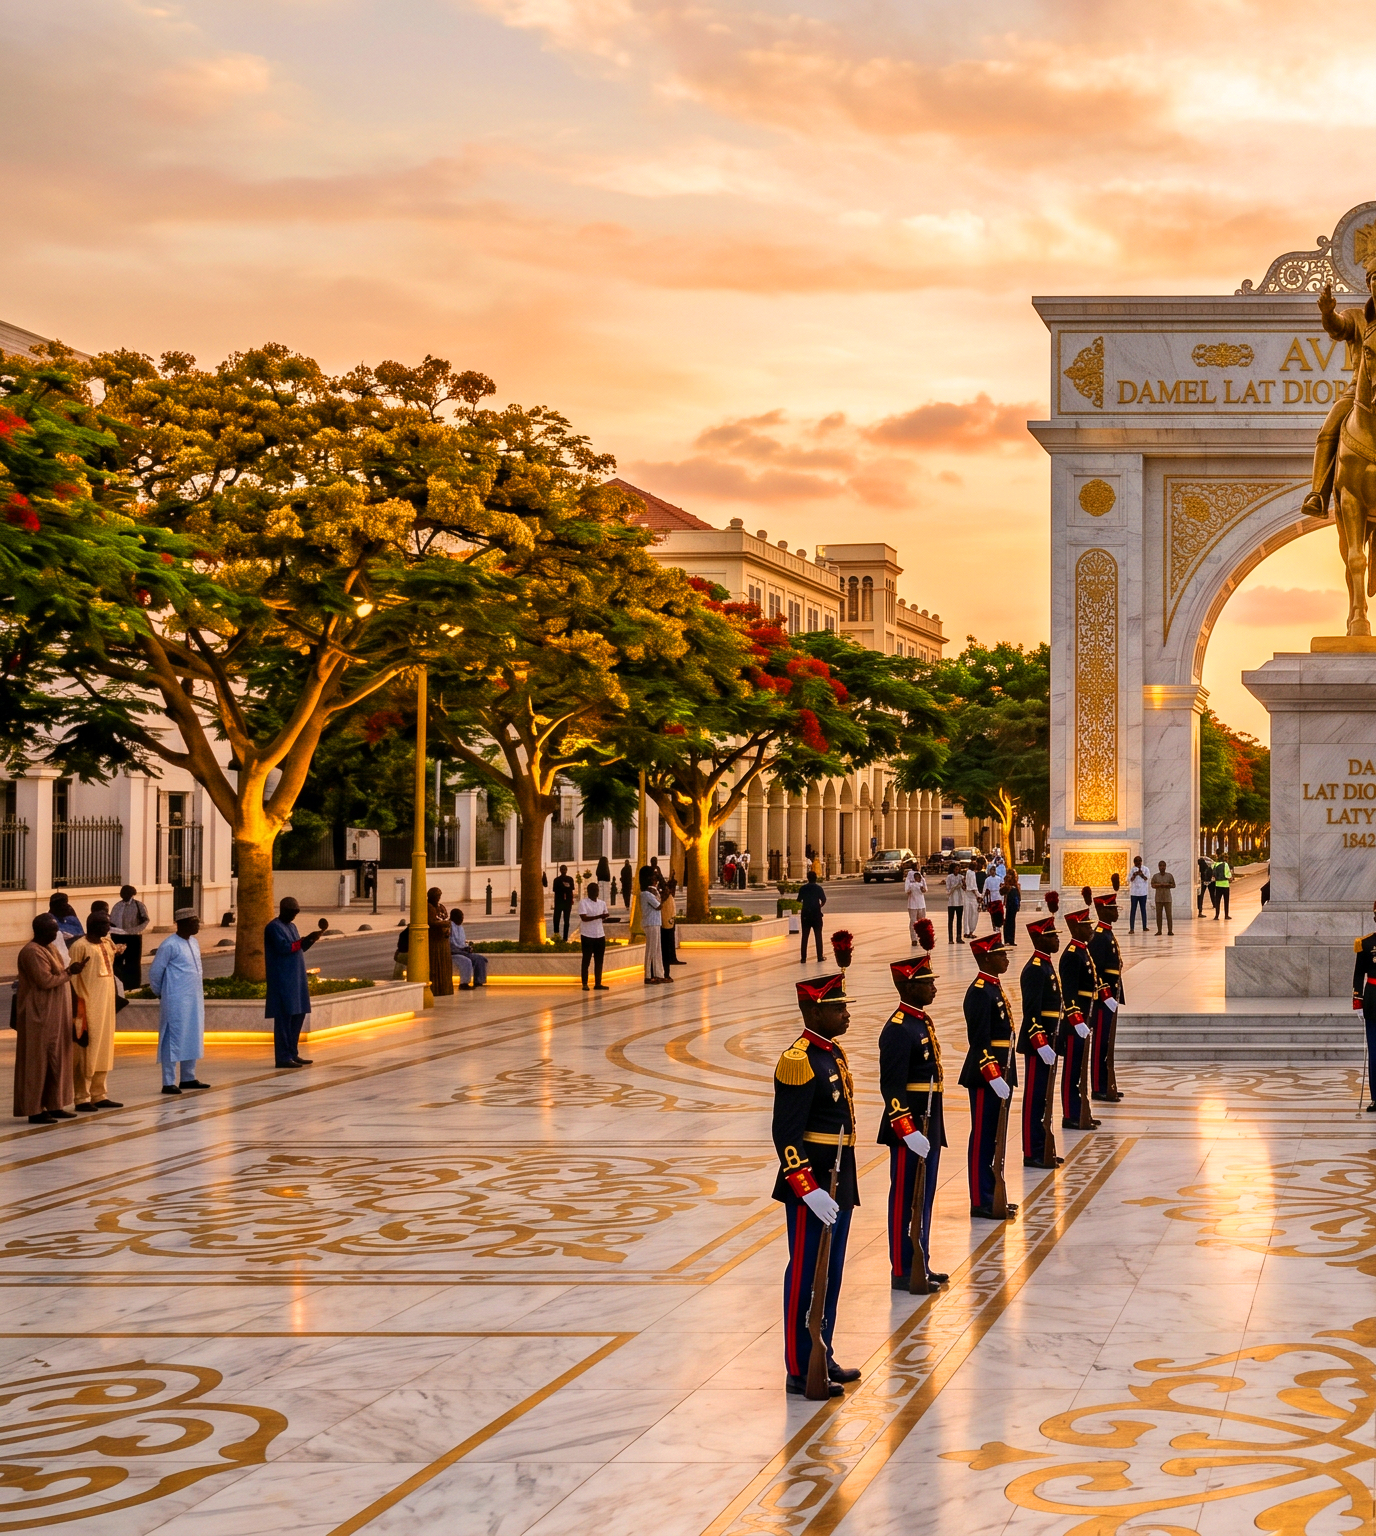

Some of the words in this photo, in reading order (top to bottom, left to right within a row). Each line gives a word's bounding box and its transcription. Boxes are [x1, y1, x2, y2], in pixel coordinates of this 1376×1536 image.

[1117, 379, 1217, 404] DAMEL
[1223, 379, 1276, 404] LAT
[1303, 783, 1339, 800] LAT
[1342, 833, 1376, 848] 1842
